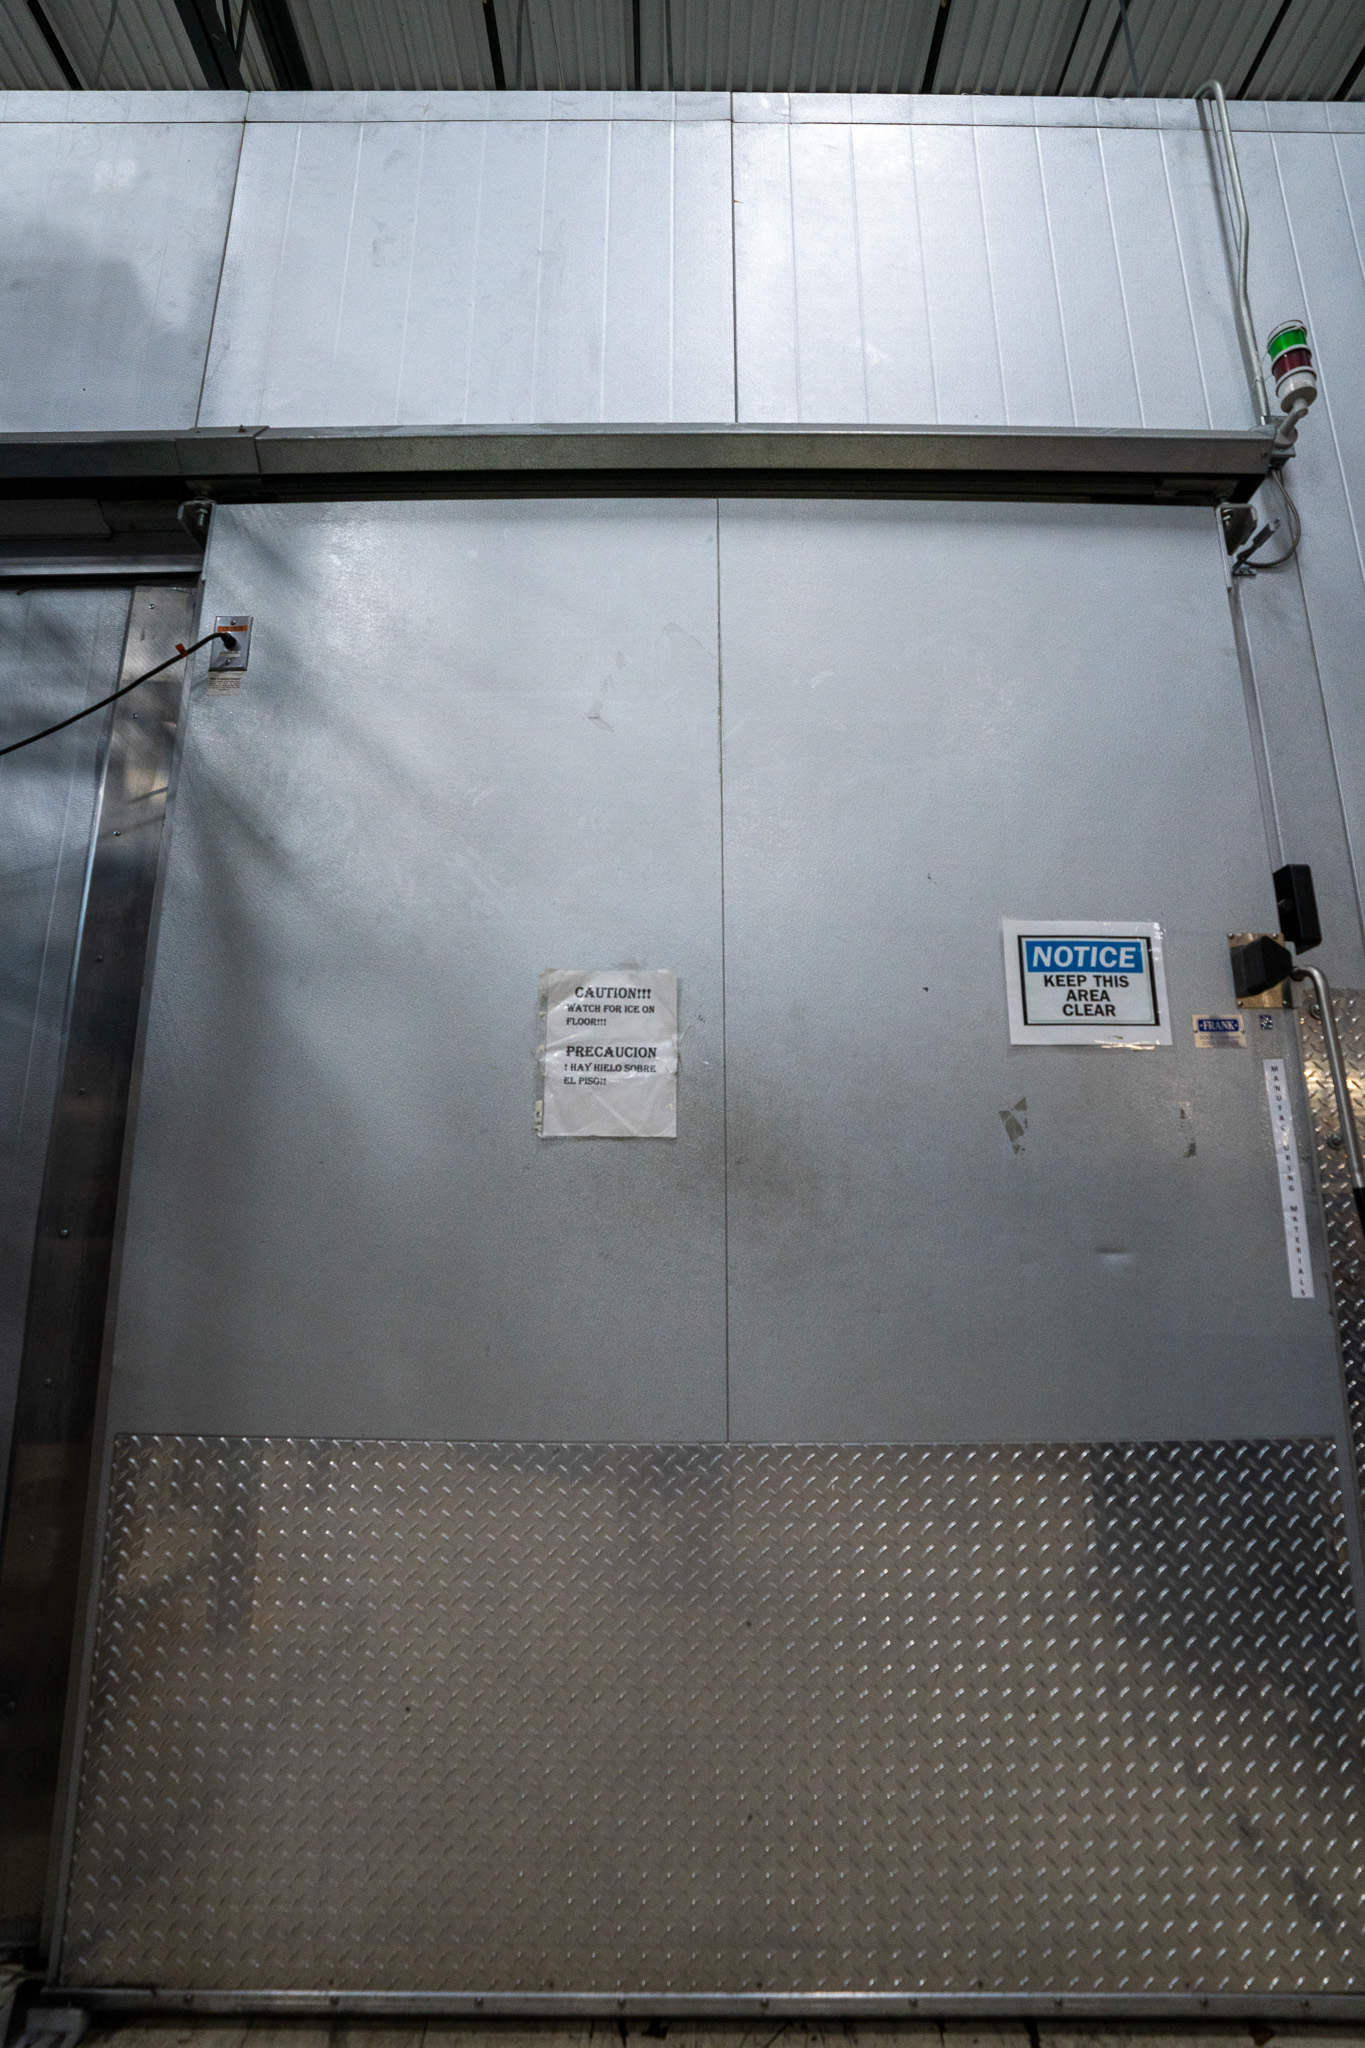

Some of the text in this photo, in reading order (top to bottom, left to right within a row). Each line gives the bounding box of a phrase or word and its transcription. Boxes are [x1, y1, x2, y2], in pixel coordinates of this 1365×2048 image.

[1032, 946, 1136, 968] NOTICE
[1043, 975, 1130, 988] KEEP THIS
[574, 986, 652, 999] CAUTION!!!
[1066, 989, 1111, 1002] AREA
[567, 1004, 655, 1014] WATCH FOR ICE ON
[1062, 1004, 1117, 1017] CLEAR
[566, 1018, 607, 1026] FLOOR!!!
[1203, 1021, 1235, 1030] FRANK
[566, 1046, 657, 1058] PRECAUCION
[570, 1063, 592, 1072] HAY
[593, 1063, 622, 1072] HIELO
[624, 1064, 657, 1073] SOBRE
[563, 1077, 577, 1085] EL
[1270, 1065, 1295, 1192] MANUFACURING
